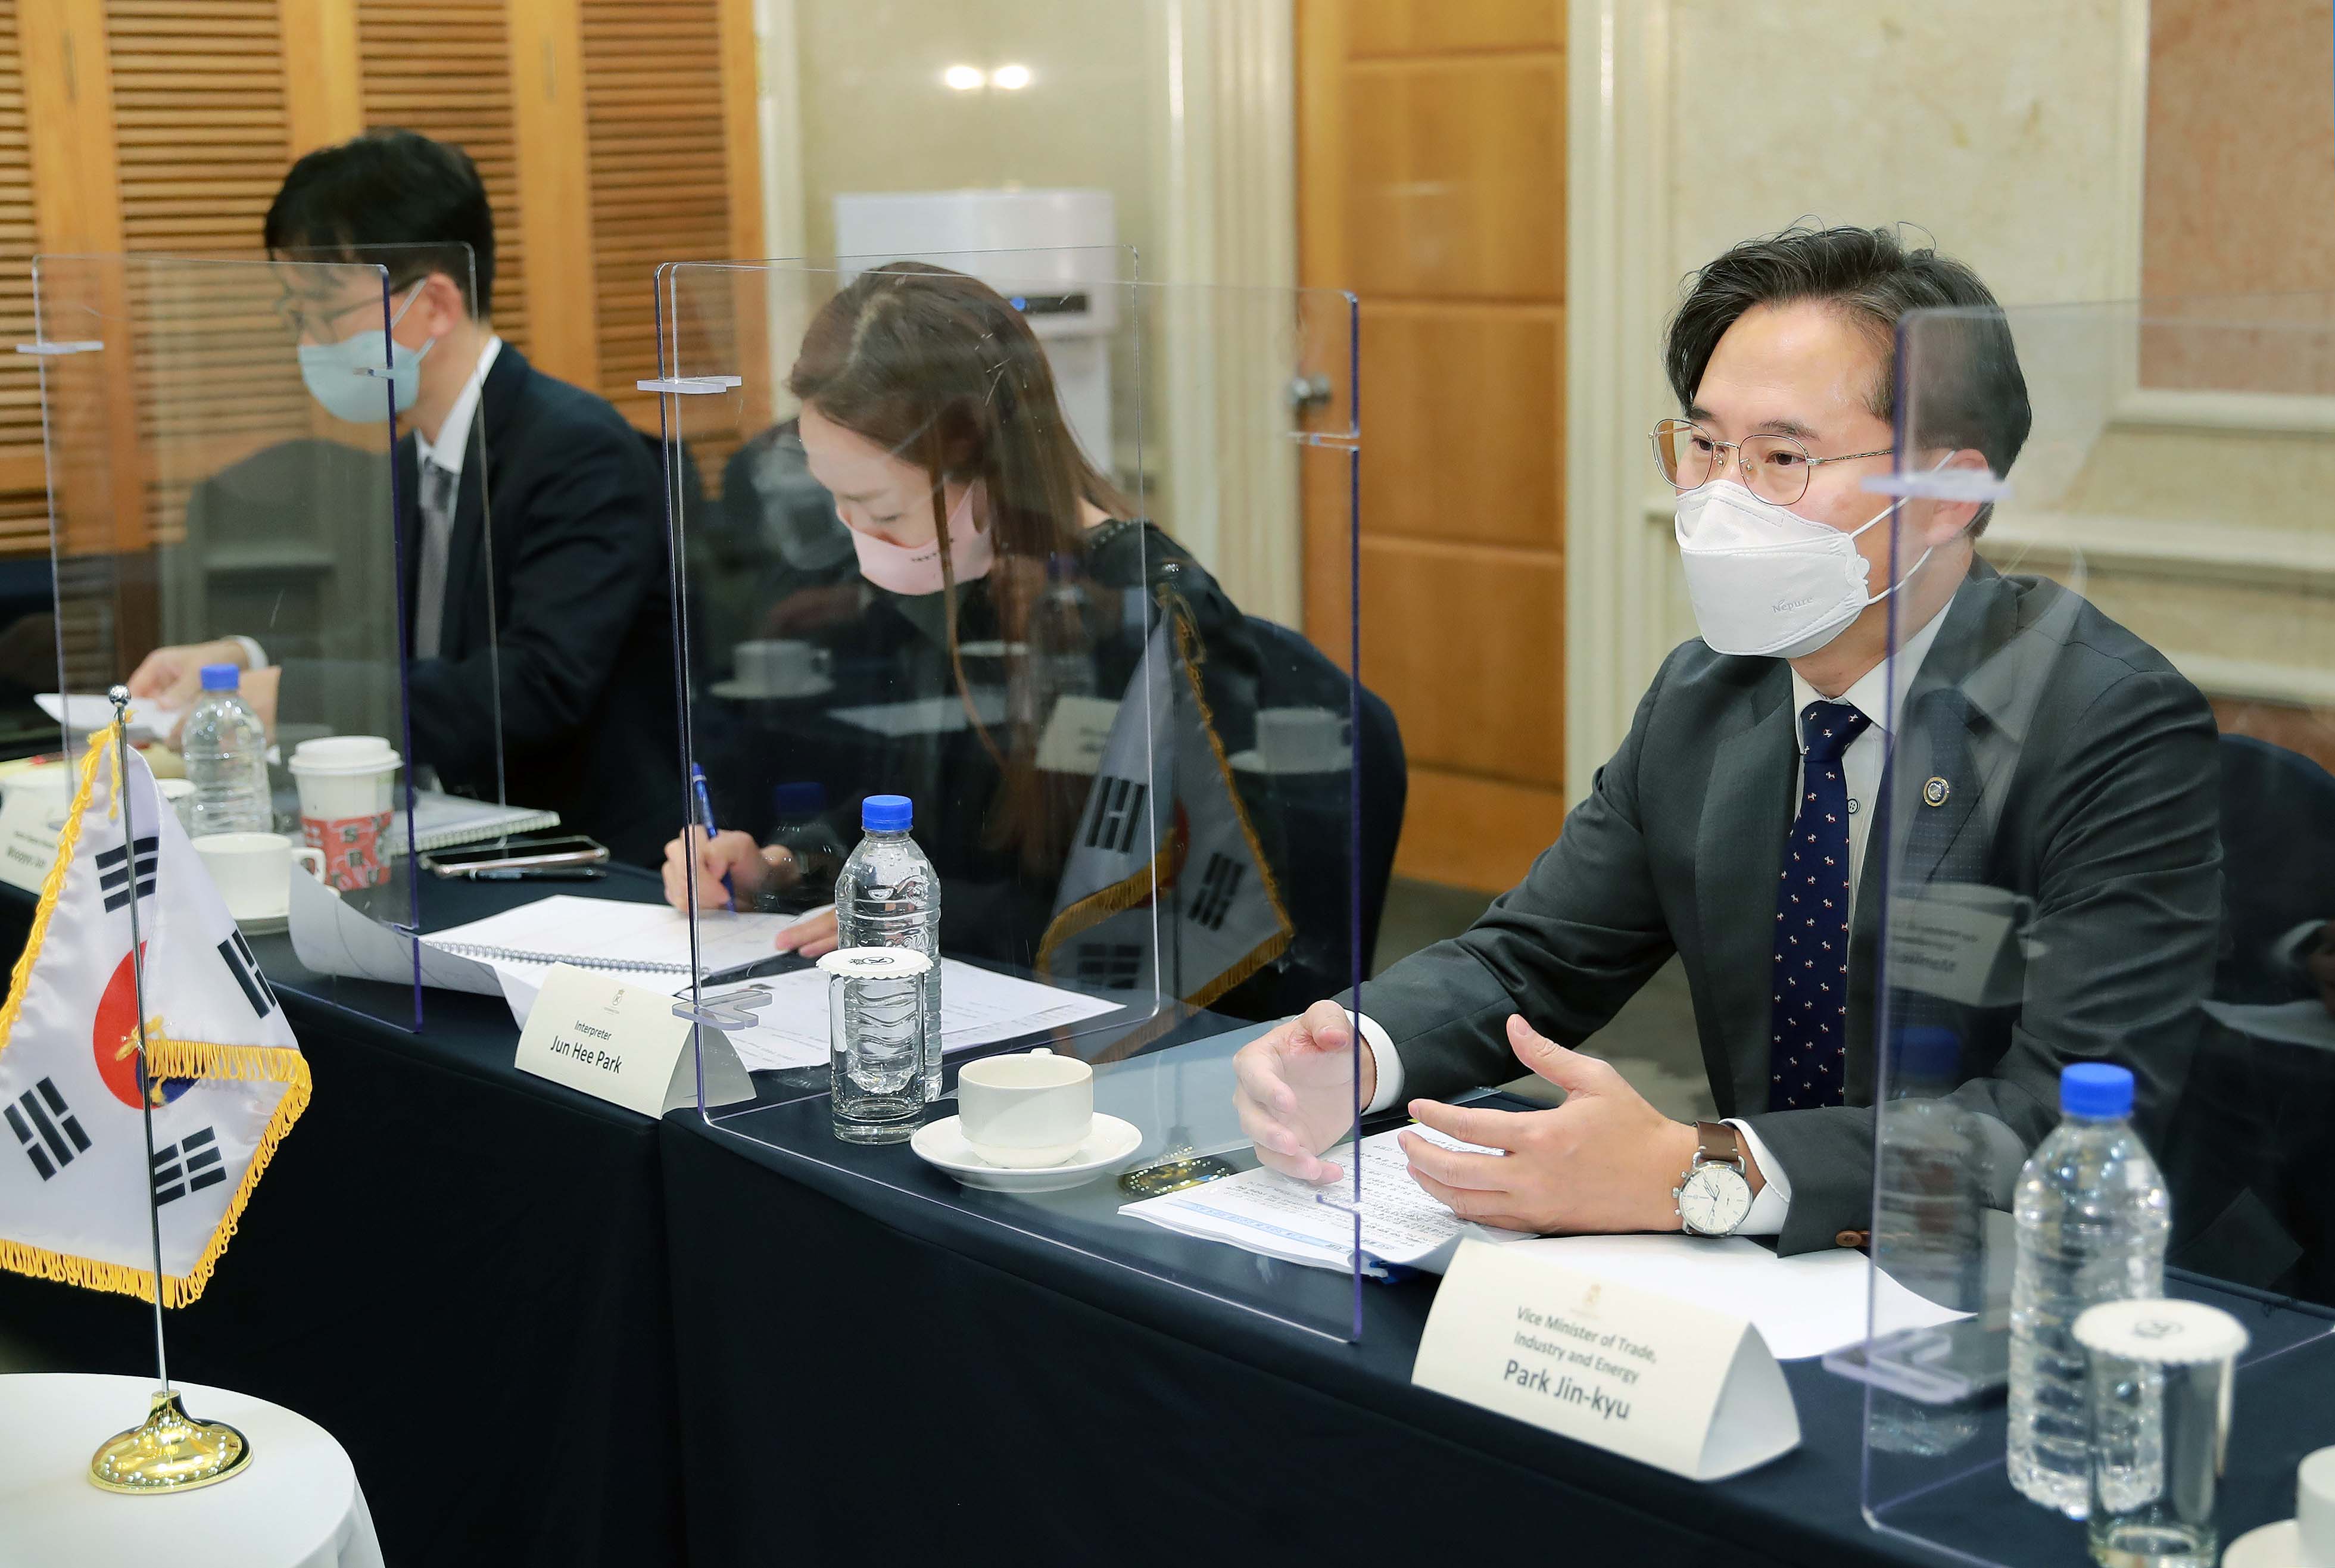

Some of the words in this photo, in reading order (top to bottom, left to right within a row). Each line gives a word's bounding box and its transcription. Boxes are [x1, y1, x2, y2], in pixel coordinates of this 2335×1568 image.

[550, 1036, 570, 1056] Jun
[572, 1042, 594, 1064] Hee
[596, 1050, 623, 1073] Park
[574, 1020, 612, 1041] Interpreter
[1514, 1331, 1566, 1361] Industry
[1567, 1351, 1594, 1367] and
[1595, 1357, 1639, 1384] Energy
[1517, 1305, 1542, 1326] Vice
[1544, 1316, 1598, 1342] Minister
[1600, 1334, 1616, 1346] of
[1619, 1338, 1657, 1363] Trade,
[1504, 1359, 1551, 1394] Park
[1553, 1378, 1631, 1420] Jin-kyu
